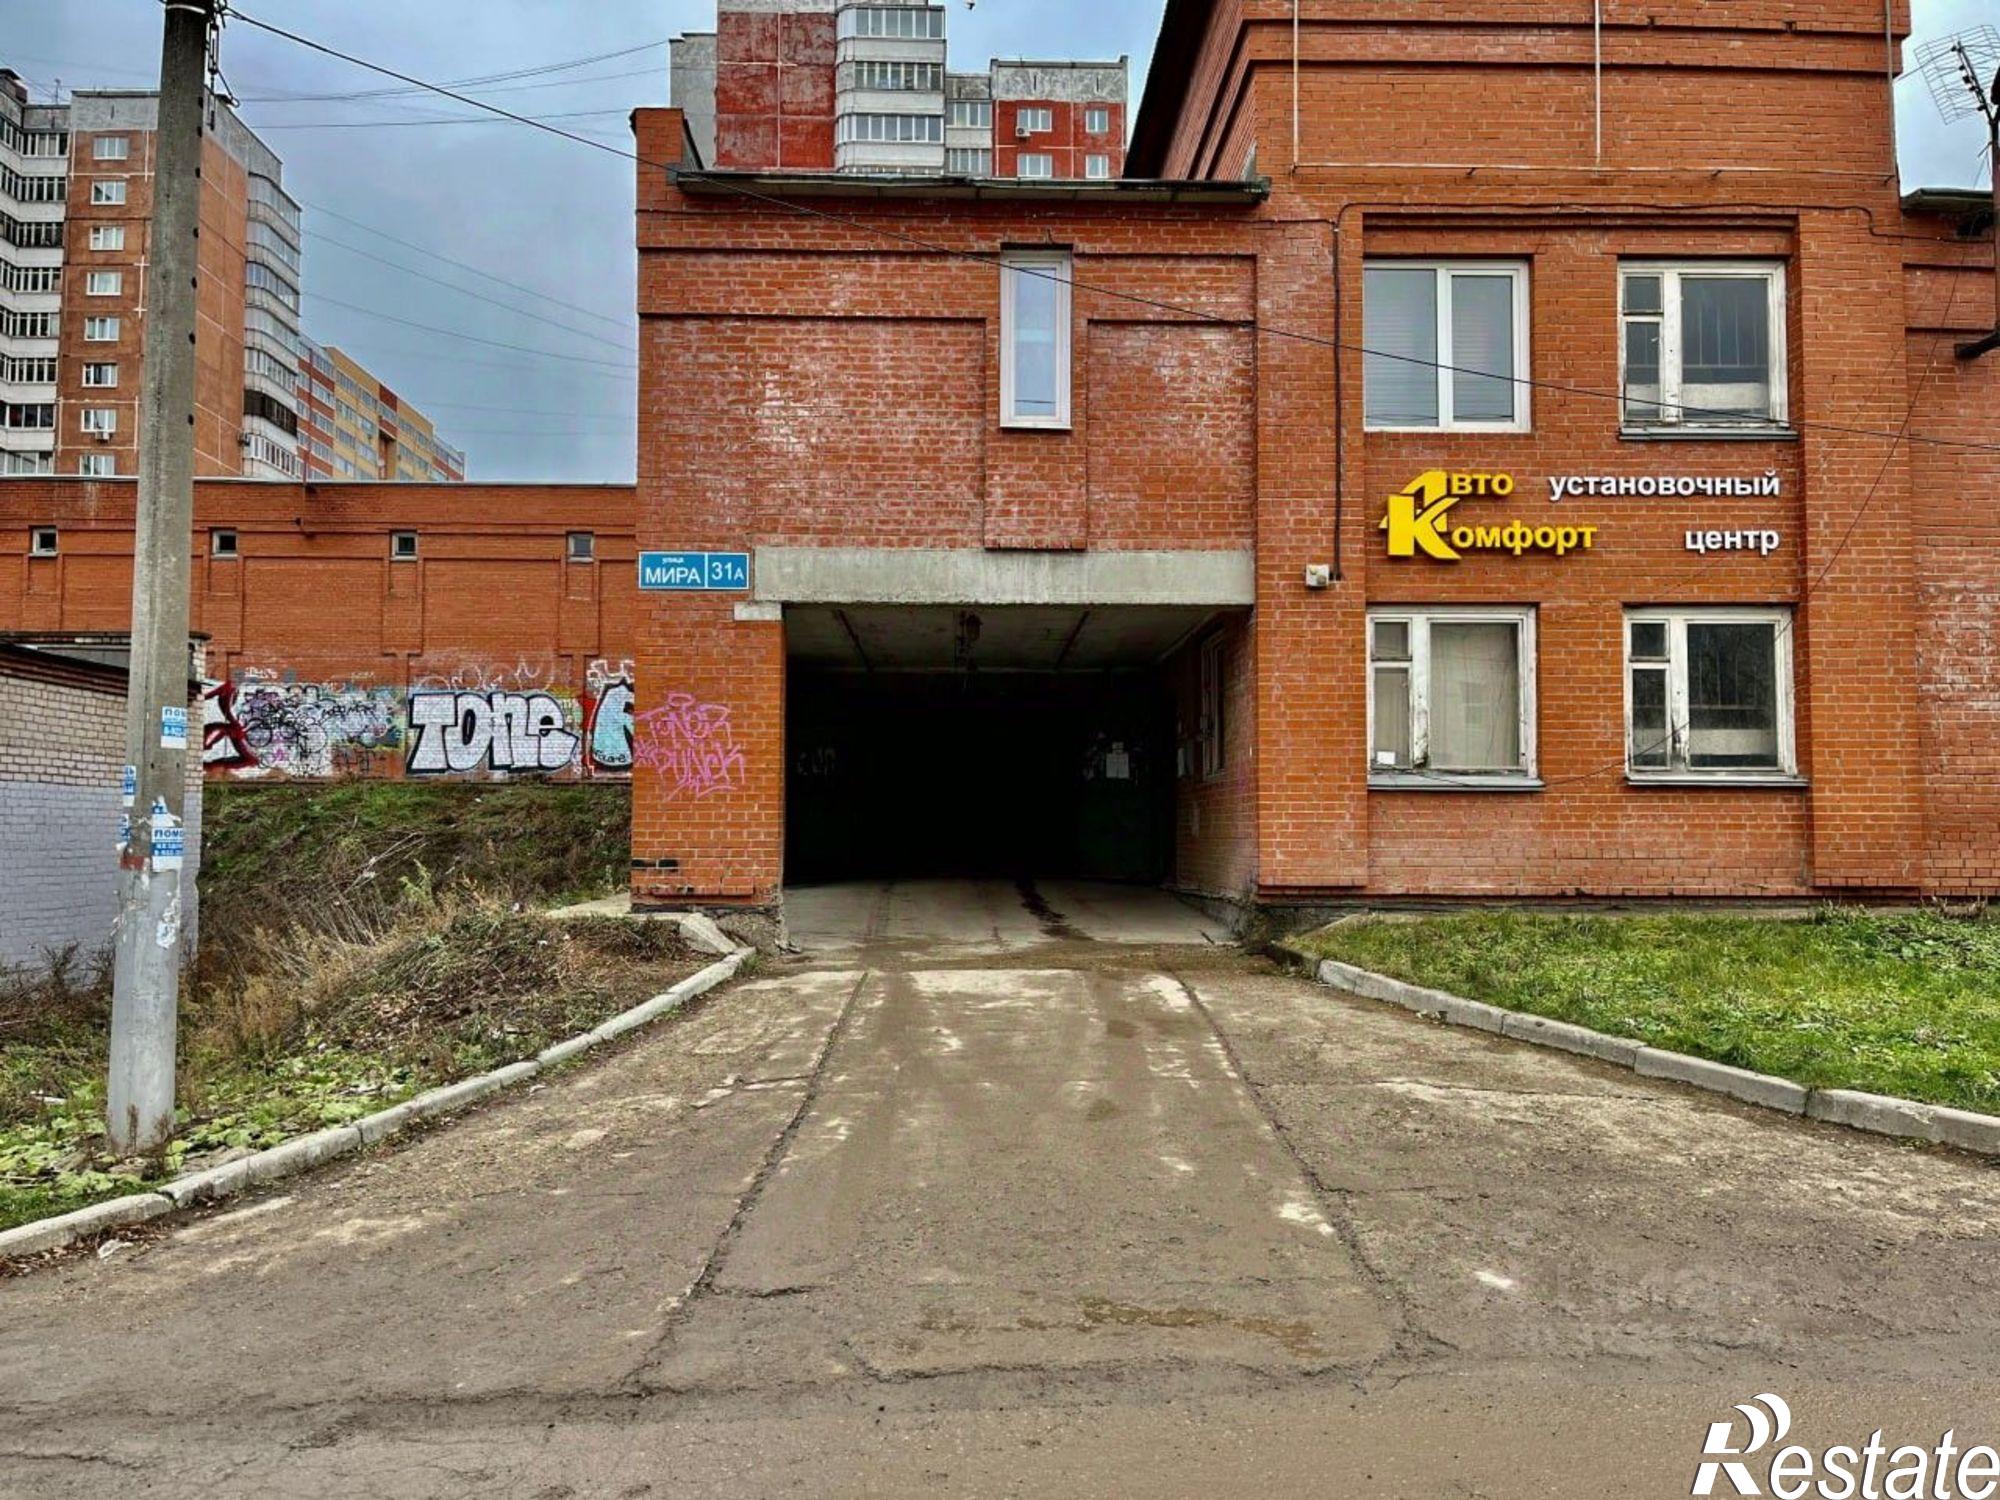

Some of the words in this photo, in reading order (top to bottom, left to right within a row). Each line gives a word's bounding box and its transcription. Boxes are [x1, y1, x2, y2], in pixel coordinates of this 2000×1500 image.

[1549, 470, 1780, 500] установочный
[1388, 495, 1597, 560] Комфорт
[1685, 527, 1780, 555] центр
[645, 567, 701, 584] МИРА
